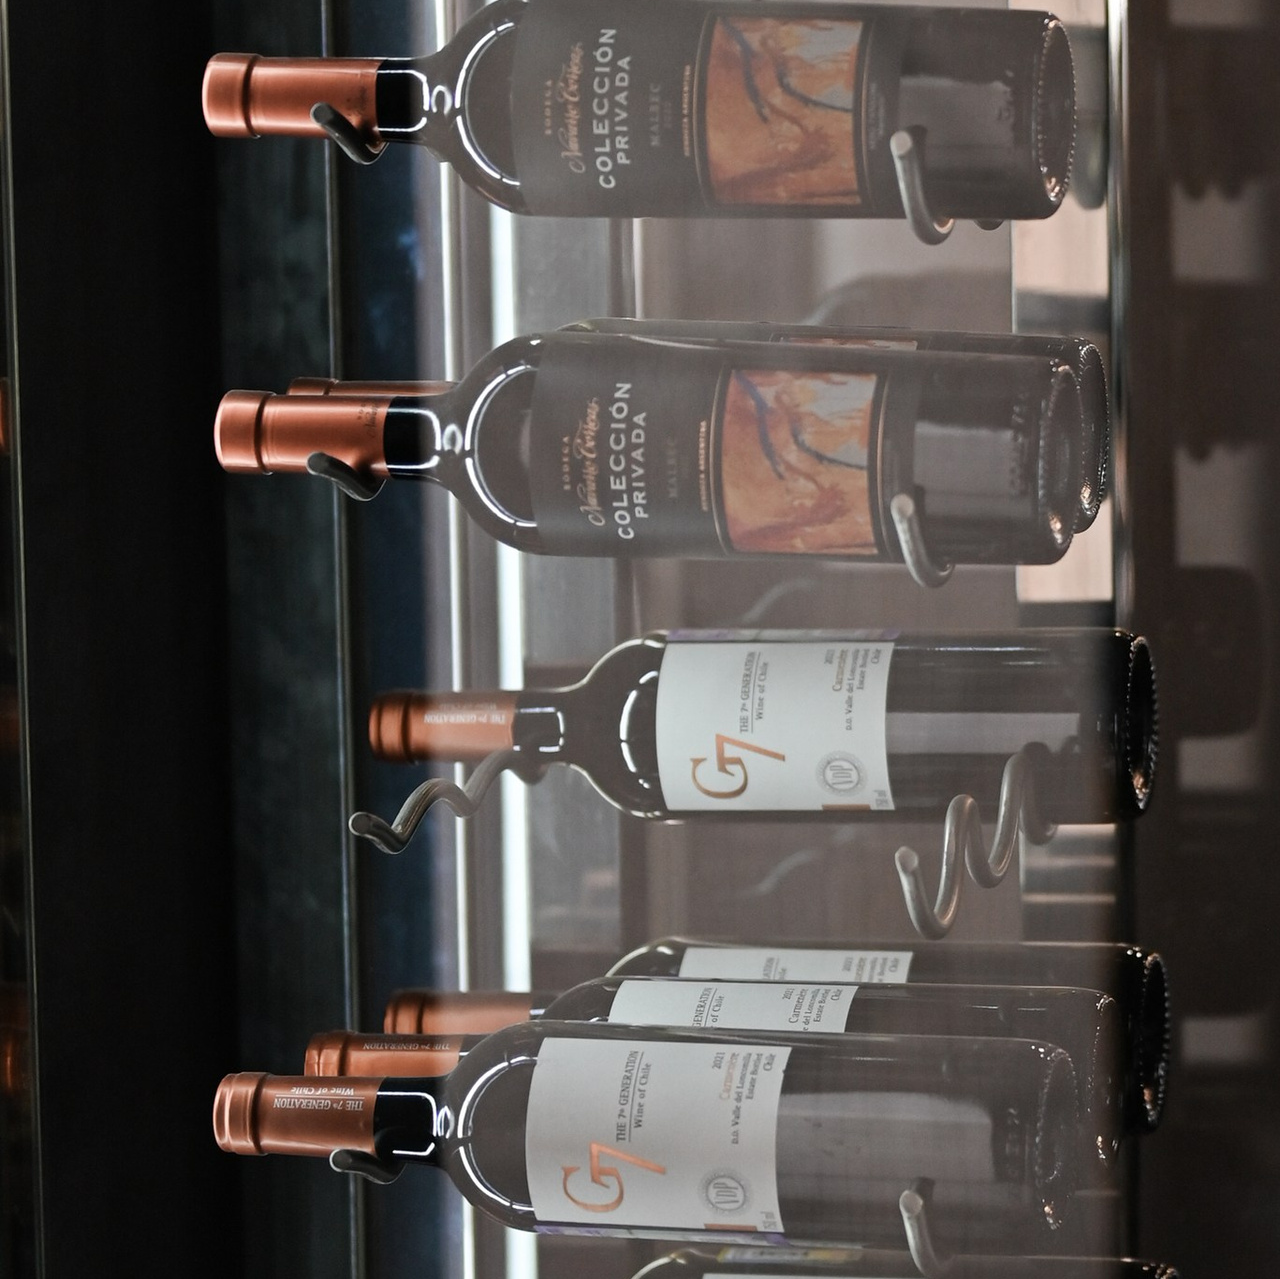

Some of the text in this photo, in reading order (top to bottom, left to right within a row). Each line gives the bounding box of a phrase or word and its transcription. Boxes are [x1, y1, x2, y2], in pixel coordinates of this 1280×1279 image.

[592, 28, 617, 190] COLECCIÓN
[615, 55, 632, 165] PRIVADA
[562, 435, 572, 490] BODEGA
[608, 382, 636, 540] COLECCIÓN
[630, 411, 649, 519] PRIVADA
[739, 651, 756, 734] THE GENERATION
[754, 661, 769, 721] Wine Chile
[690, 733, 786, 800] G7
[692, 987, 713, 1027] GENERATION
[711, 995, 725, 1023] of Chile
[782, 987, 796, 1000] 2021
[788, 988, 809, 1024] Carmenère
[830, 988, 843, 1001] Chile
[273, 1097, 363, 1111] THE GENERATION
[317, 1086, 329, 1094] of
[330, 1087, 355, 1096] Wine
[615, 1050, 640, 1143] THE 7th GENERATION
[633, 1062, 652, 1129] Wine of Chile
[560, 1140, 667, 1214] G7
[713, 1182, 739, 1206] VDP
